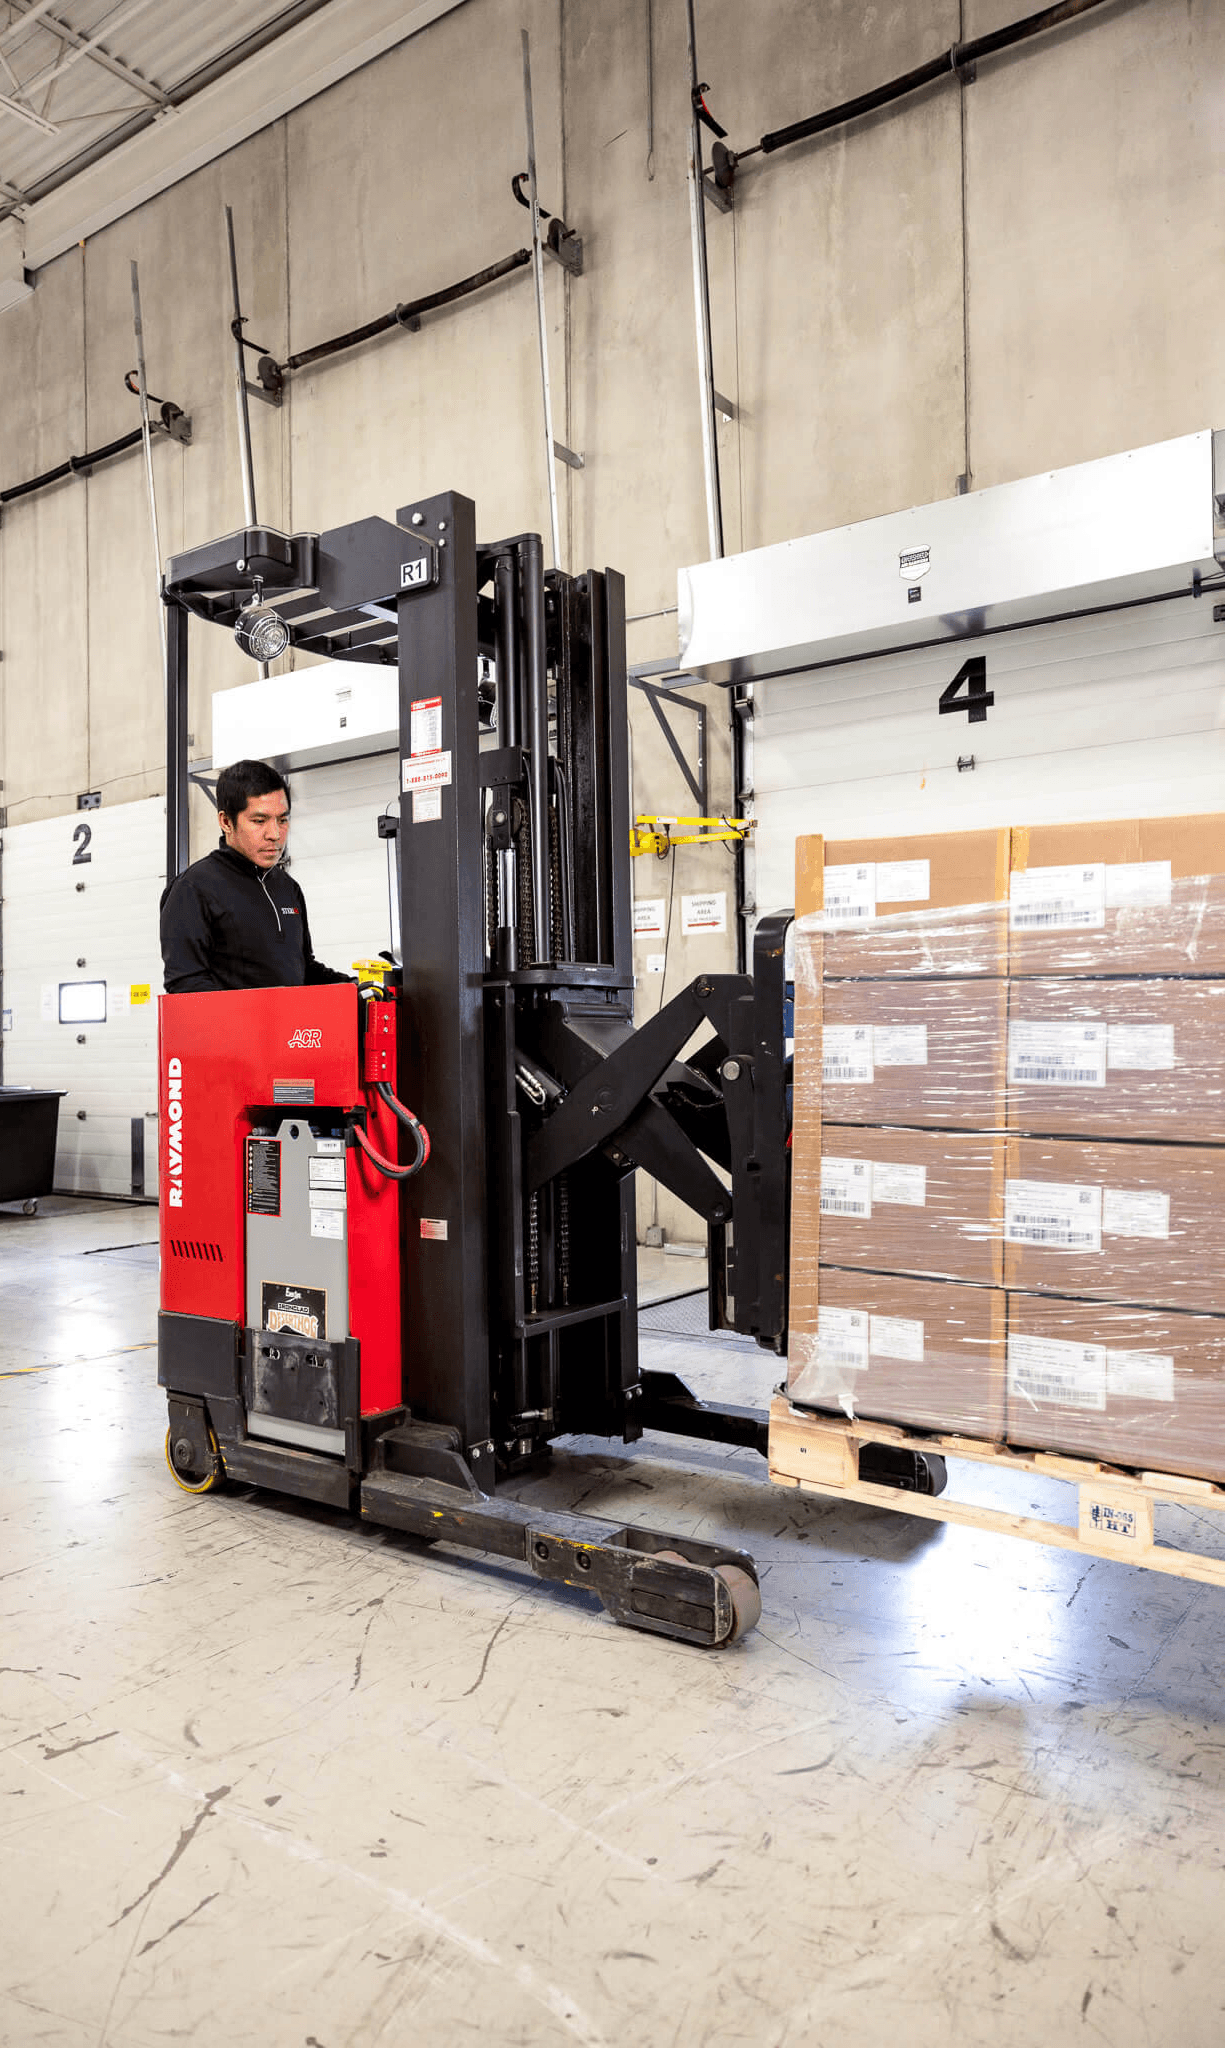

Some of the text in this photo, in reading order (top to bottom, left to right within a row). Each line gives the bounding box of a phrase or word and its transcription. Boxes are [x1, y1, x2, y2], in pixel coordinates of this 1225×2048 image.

[403, 561, 421, 583] R1
[939, 656, 994, 723] 4
[72, 824, 91, 864] 2
[288, 1029, 322, 1048] ACR
[168, 1057, 183, 1208] RAYMOND
[278, 1303, 309, 1314] IRONCLAD
